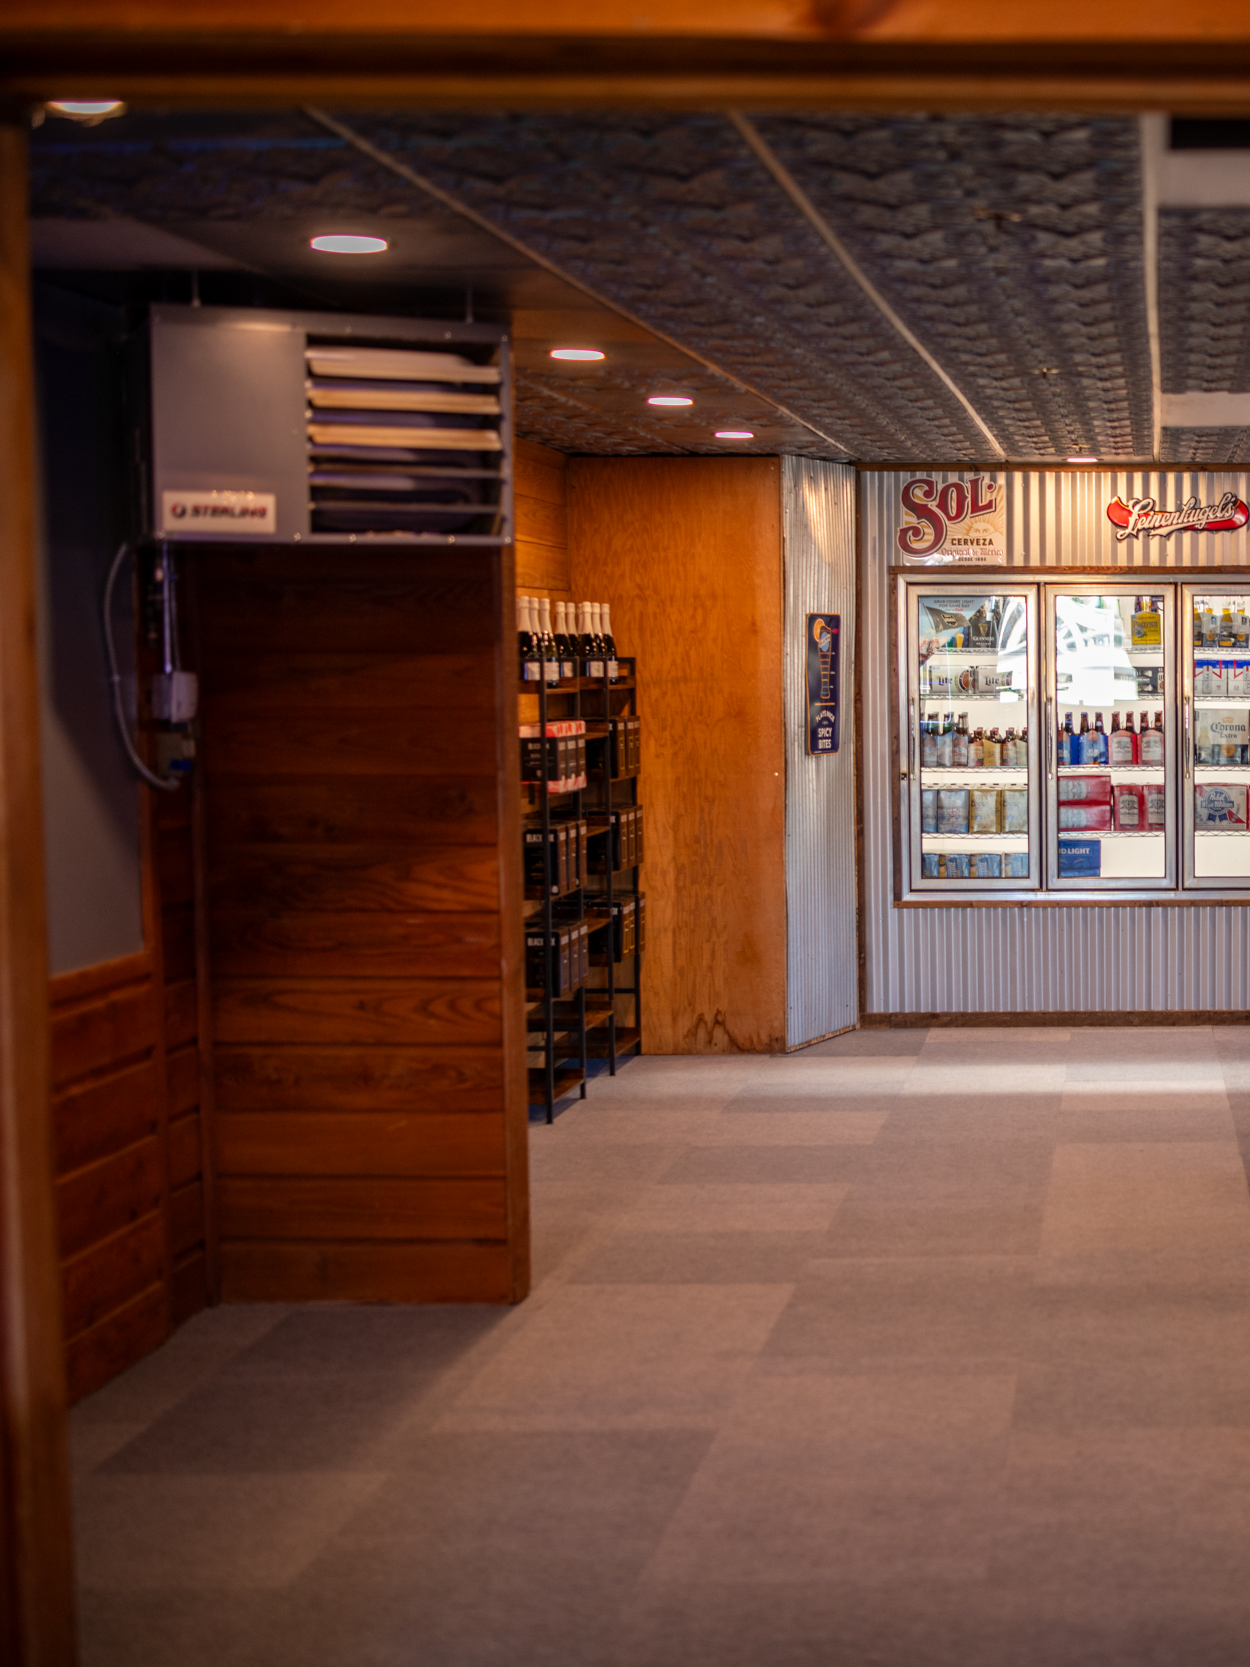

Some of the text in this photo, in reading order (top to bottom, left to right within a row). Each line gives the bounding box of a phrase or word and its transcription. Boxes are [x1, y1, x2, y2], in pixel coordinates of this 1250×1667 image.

[1116, 492, 1235, 540] Leinenkugel's
[951, 538, 994, 546] CERVEZA
[985, 676, 999, 686] Lite
[1210, 721, 1246, 734] Corona
[818, 728, 833, 738] SPICY
[1219, 731, 1238, 739] Extra
[818, 739, 832, 749] BITES
[526, 833, 543, 843] BLACK
[527, 937, 544, 946] BLACK
